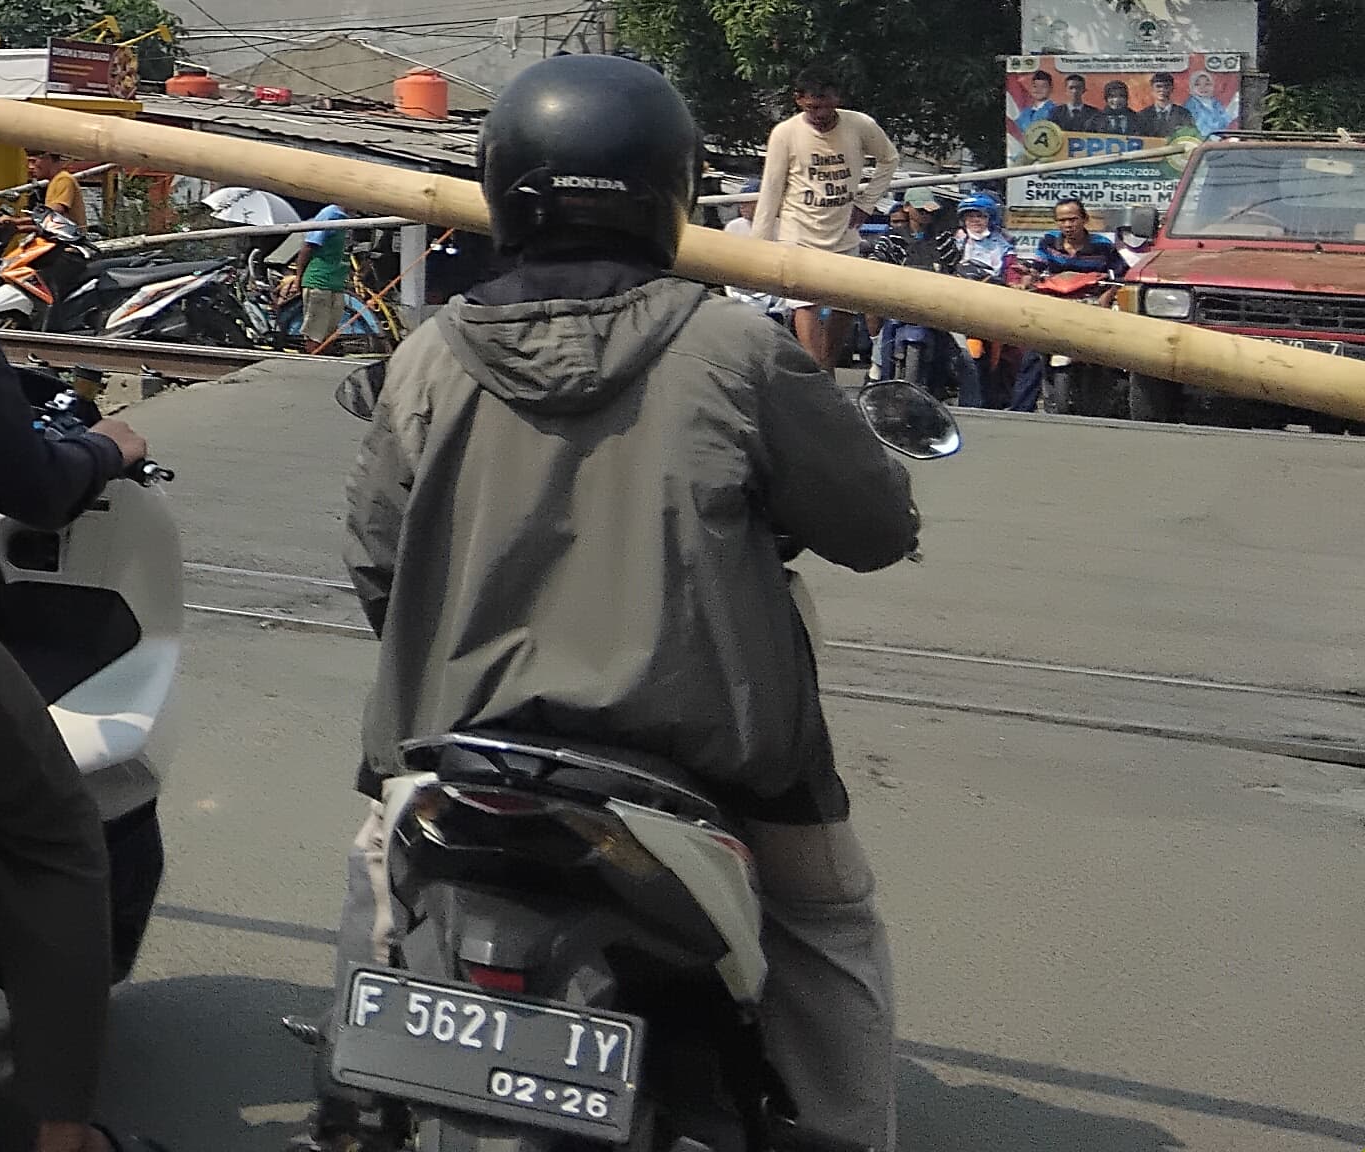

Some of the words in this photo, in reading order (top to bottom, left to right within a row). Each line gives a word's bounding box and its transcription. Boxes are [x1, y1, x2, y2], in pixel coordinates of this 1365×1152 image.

[1034, 132, 1049, 148] A
[1108, 167, 1162, 177] 2025/2026
[550, 175, 628, 191] HONDA
[1026, 179, 1098, 191] Penerimaan
[1102, 180, 1150, 192] Peserta
[1025, 190, 1105, 202] SMK-SMP
[1110, 190, 1153, 203] Islam
[355, 985, 383, 1027] F
[405, 992, 508, 1052] 5621
[563, 1023, 619, 1073] IY
